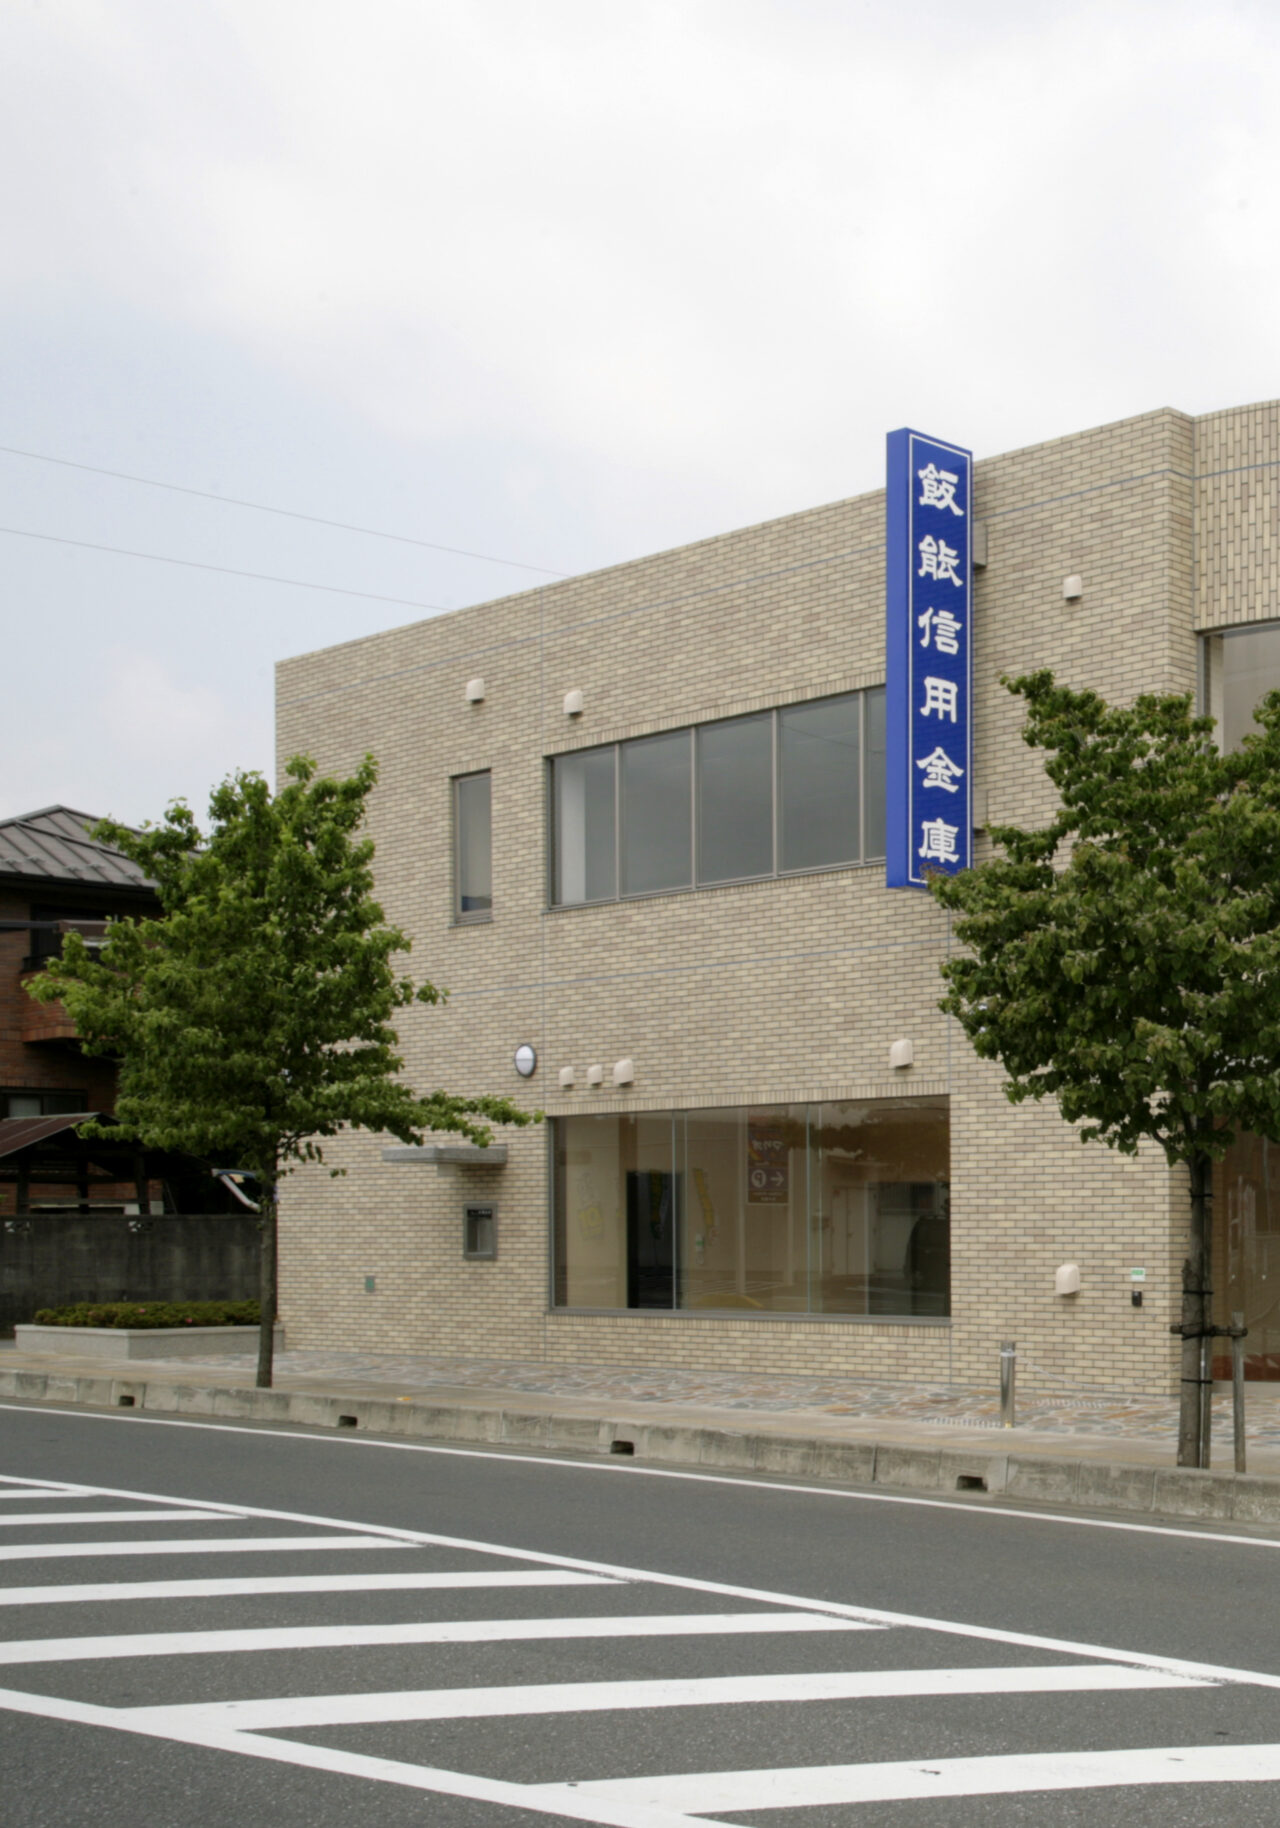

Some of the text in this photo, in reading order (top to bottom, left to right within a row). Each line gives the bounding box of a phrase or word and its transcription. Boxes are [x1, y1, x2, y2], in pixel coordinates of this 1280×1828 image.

[916, 462, 964, 864] 飯能信用金庫
